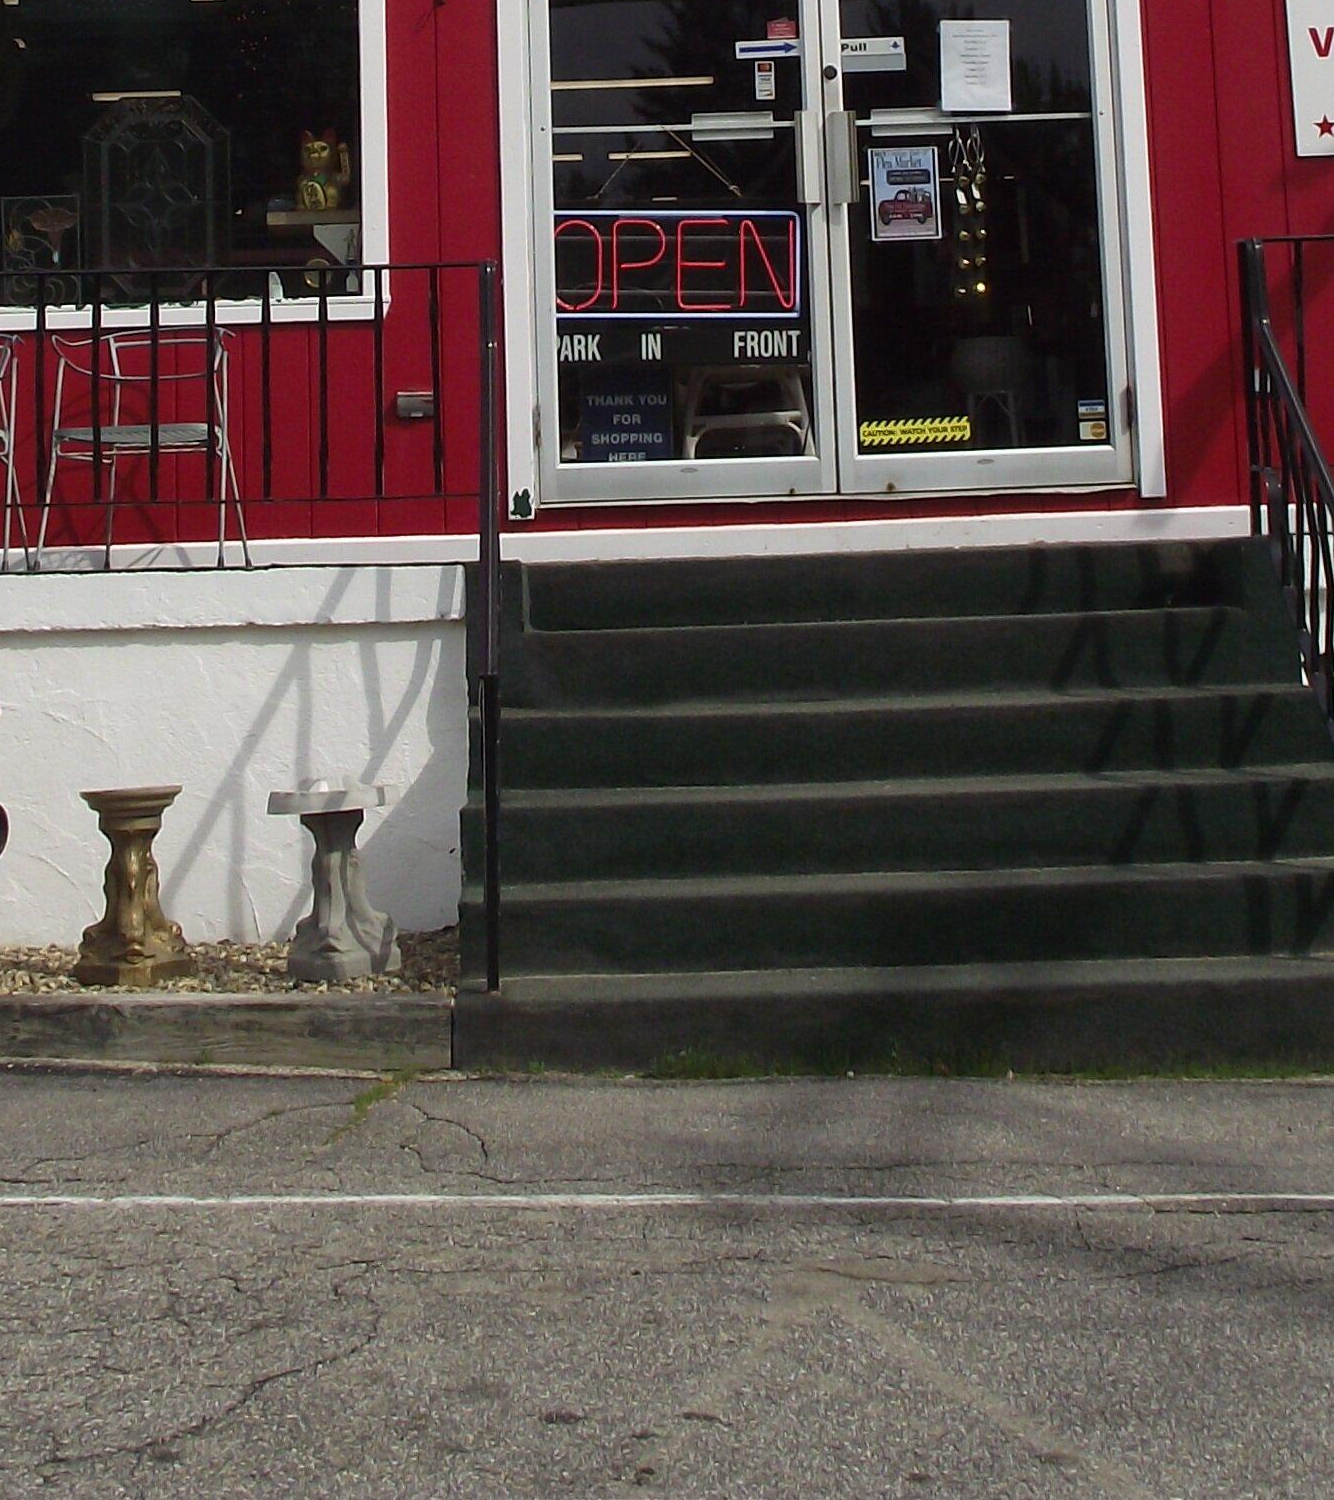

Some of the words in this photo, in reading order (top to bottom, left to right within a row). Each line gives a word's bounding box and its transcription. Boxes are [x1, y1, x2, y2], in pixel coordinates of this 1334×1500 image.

[841, 42, 867, 53] Pull
[554, 219, 796, 311] OPEN
[640, 333, 662, 360] IN
[733, 330, 801, 358] FRONT
[586, 395, 634, 406] THANK
[639, 394, 668, 406] YOU
[612, 414, 642, 425] FOR
[591, 432, 663, 445] SHOPPING
